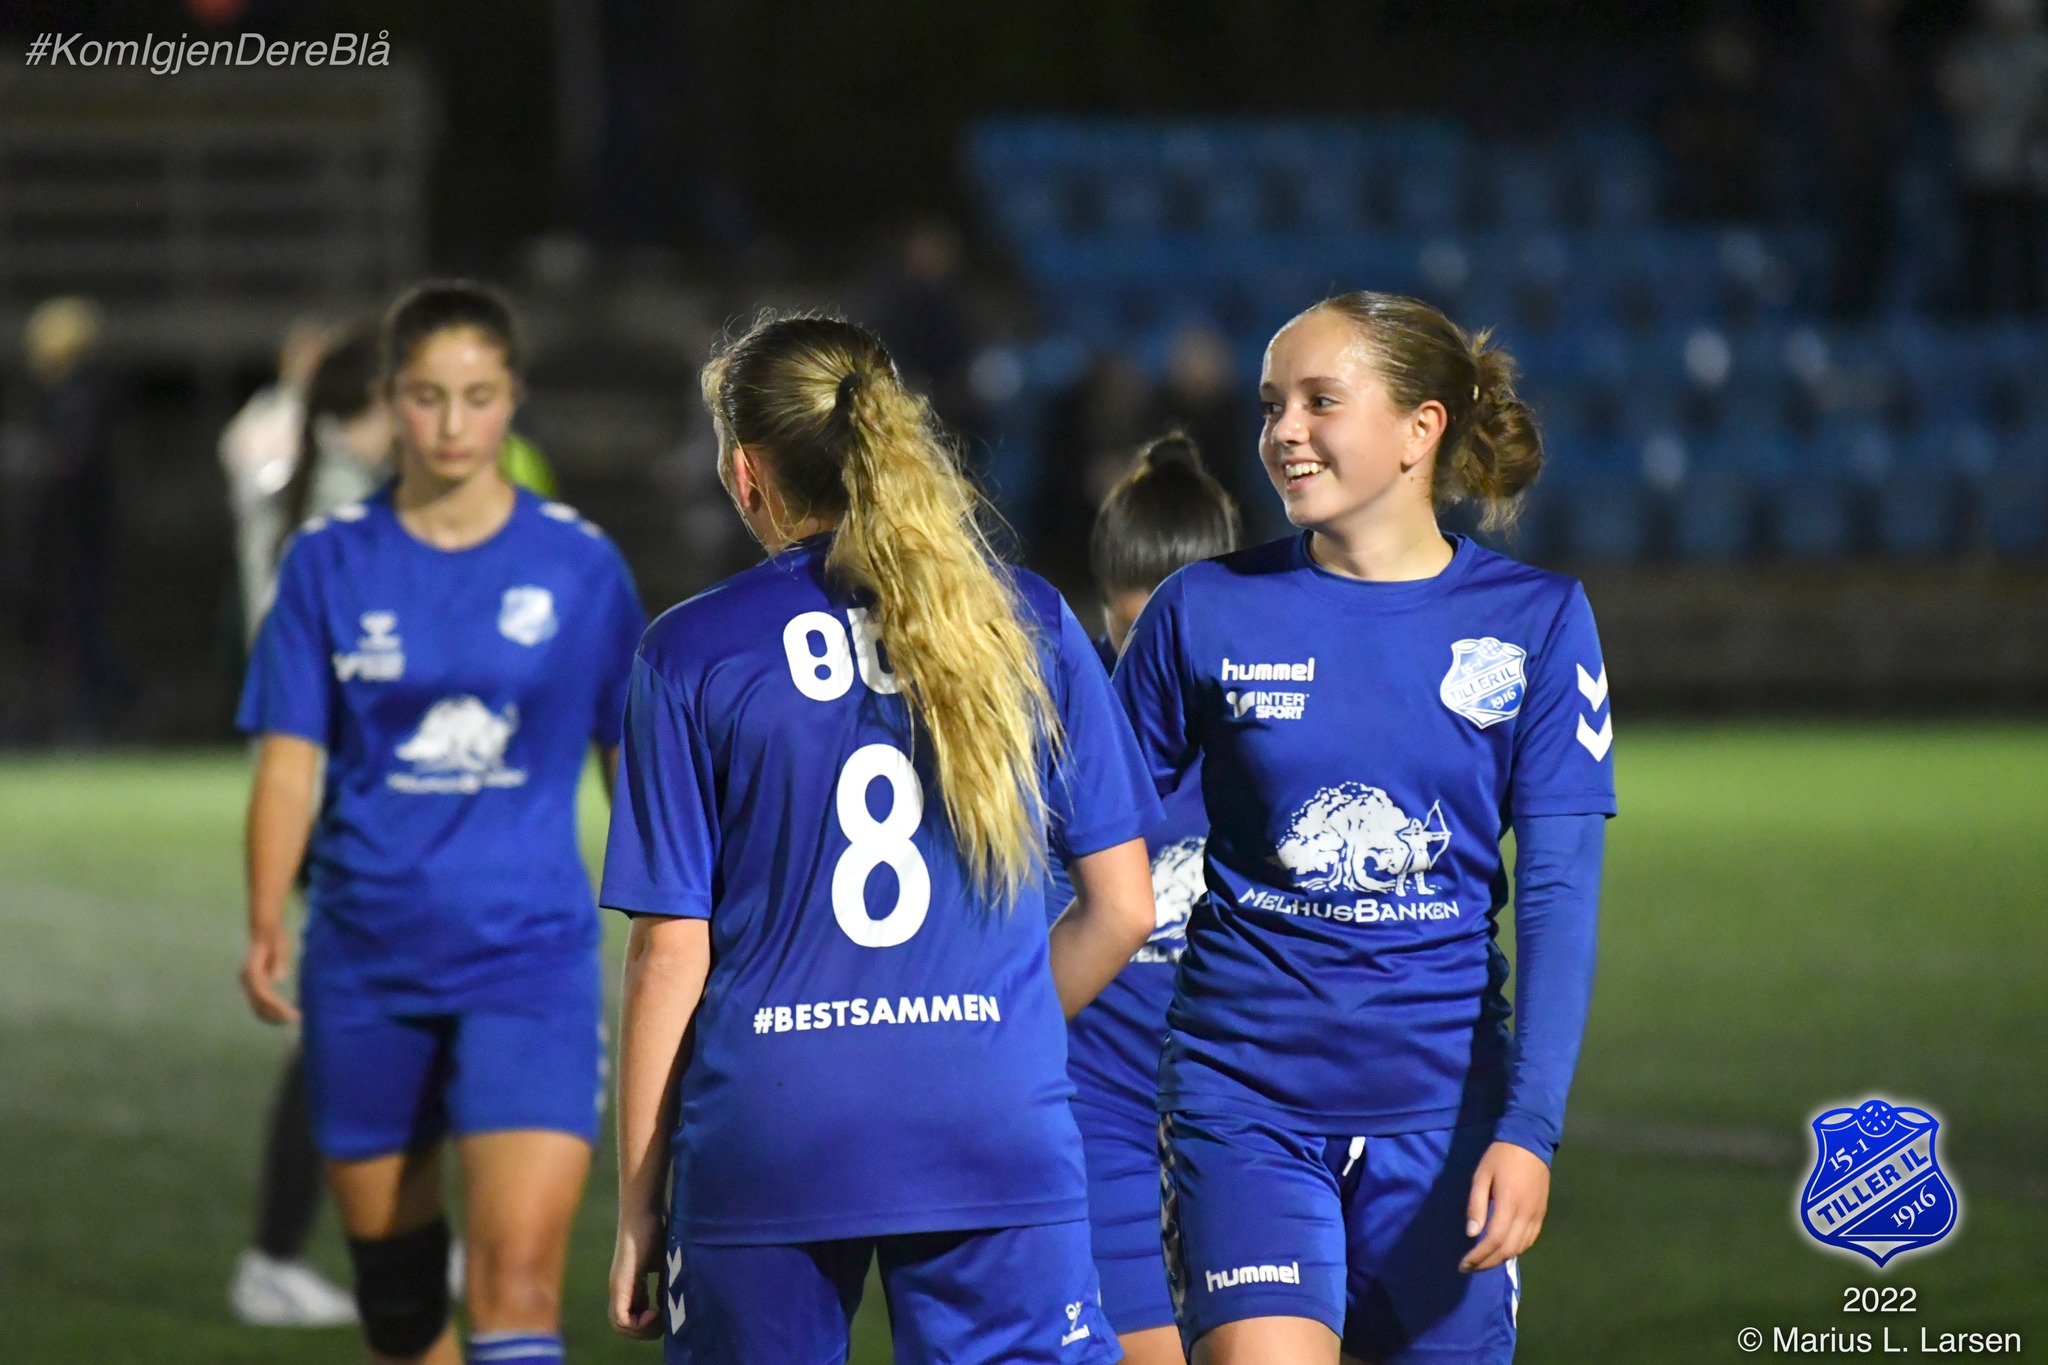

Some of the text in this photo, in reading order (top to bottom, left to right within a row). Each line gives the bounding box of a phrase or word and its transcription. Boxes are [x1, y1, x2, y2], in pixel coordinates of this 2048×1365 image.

[1222, 656, 1315, 682] hummel
[1256, 691, 1305, 706] INTER
[1491, 686, 1517, 710] 1916
[1255, 705, 1304, 720] SPORT
[831, 743, 931, 948] 8
[753, 994, 1001, 1035] #BESTSAMMEN
[1206, 1260, 1300, 1293] hummel
